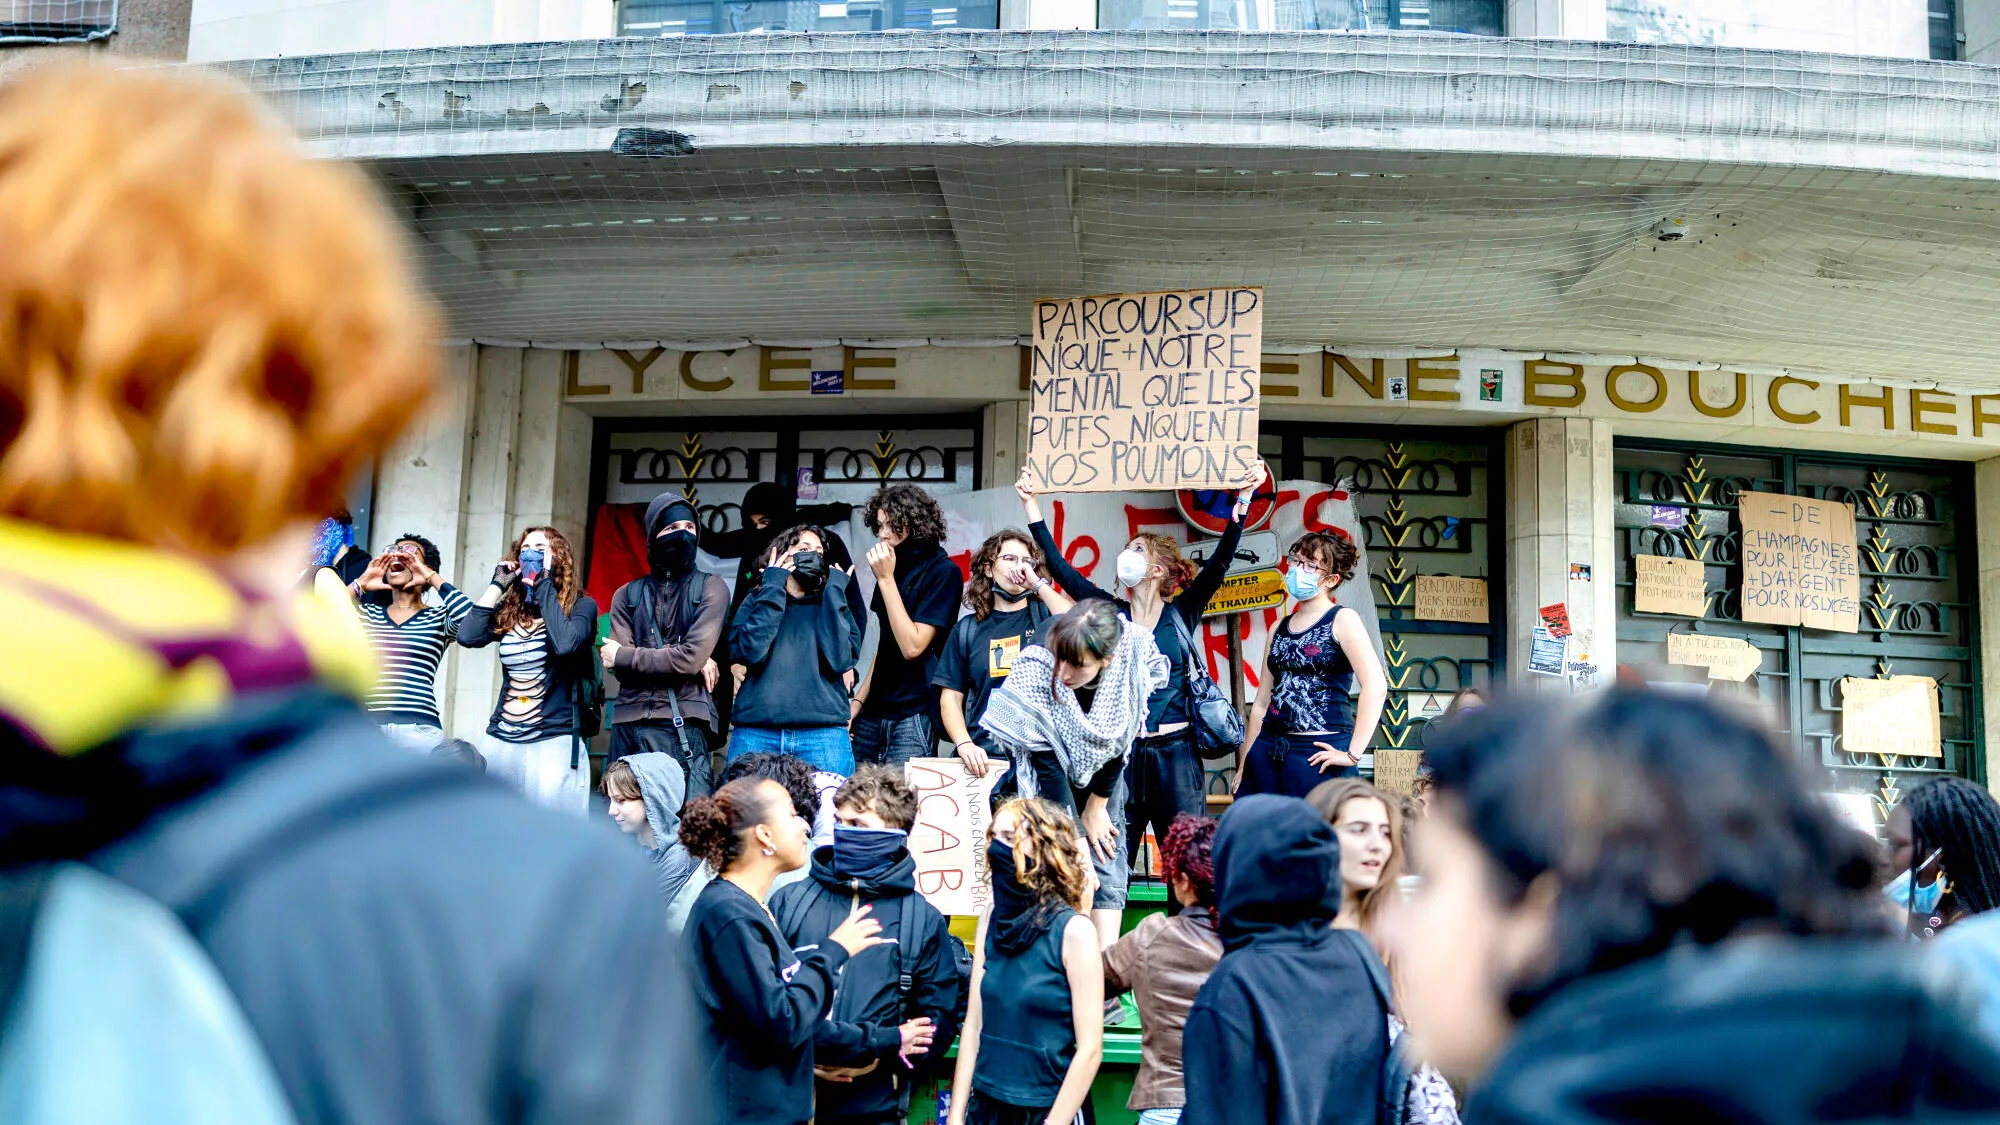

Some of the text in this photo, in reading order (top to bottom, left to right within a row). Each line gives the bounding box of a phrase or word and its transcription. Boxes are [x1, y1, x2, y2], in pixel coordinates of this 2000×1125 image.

[1039, 290, 1258, 340] PARCOURSUP
[1033, 336, 1120, 377] NIQUE
[1140, 334, 1252, 370] NOTRE
[1030, 369, 1256, 413] MENTAL QUE LES
[1028, 407, 1258, 453] PUFFS NIQUENT
[1029, 440, 1253, 489] NOS POUMONS
[1793, 503, 1821, 524] DE
[1744, 529, 1851, 559] CHAMPAGNES
[1747, 550, 1787, 568] POUR
[1418, 577, 1482, 594] BONJOUR JE
[1747, 588, 1790, 608] POUR
[1219, 595, 1271, 608] TRAVAUX
[1417, 594, 1444, 607] VIENS
[1418, 608, 1471, 619] MON AVENIR
[1376, 751, 1391, 765] MA
[965, 792, 982, 826] NOUS
[912, 765, 964, 896] ACAB
[971, 885, 989, 913] BAC
